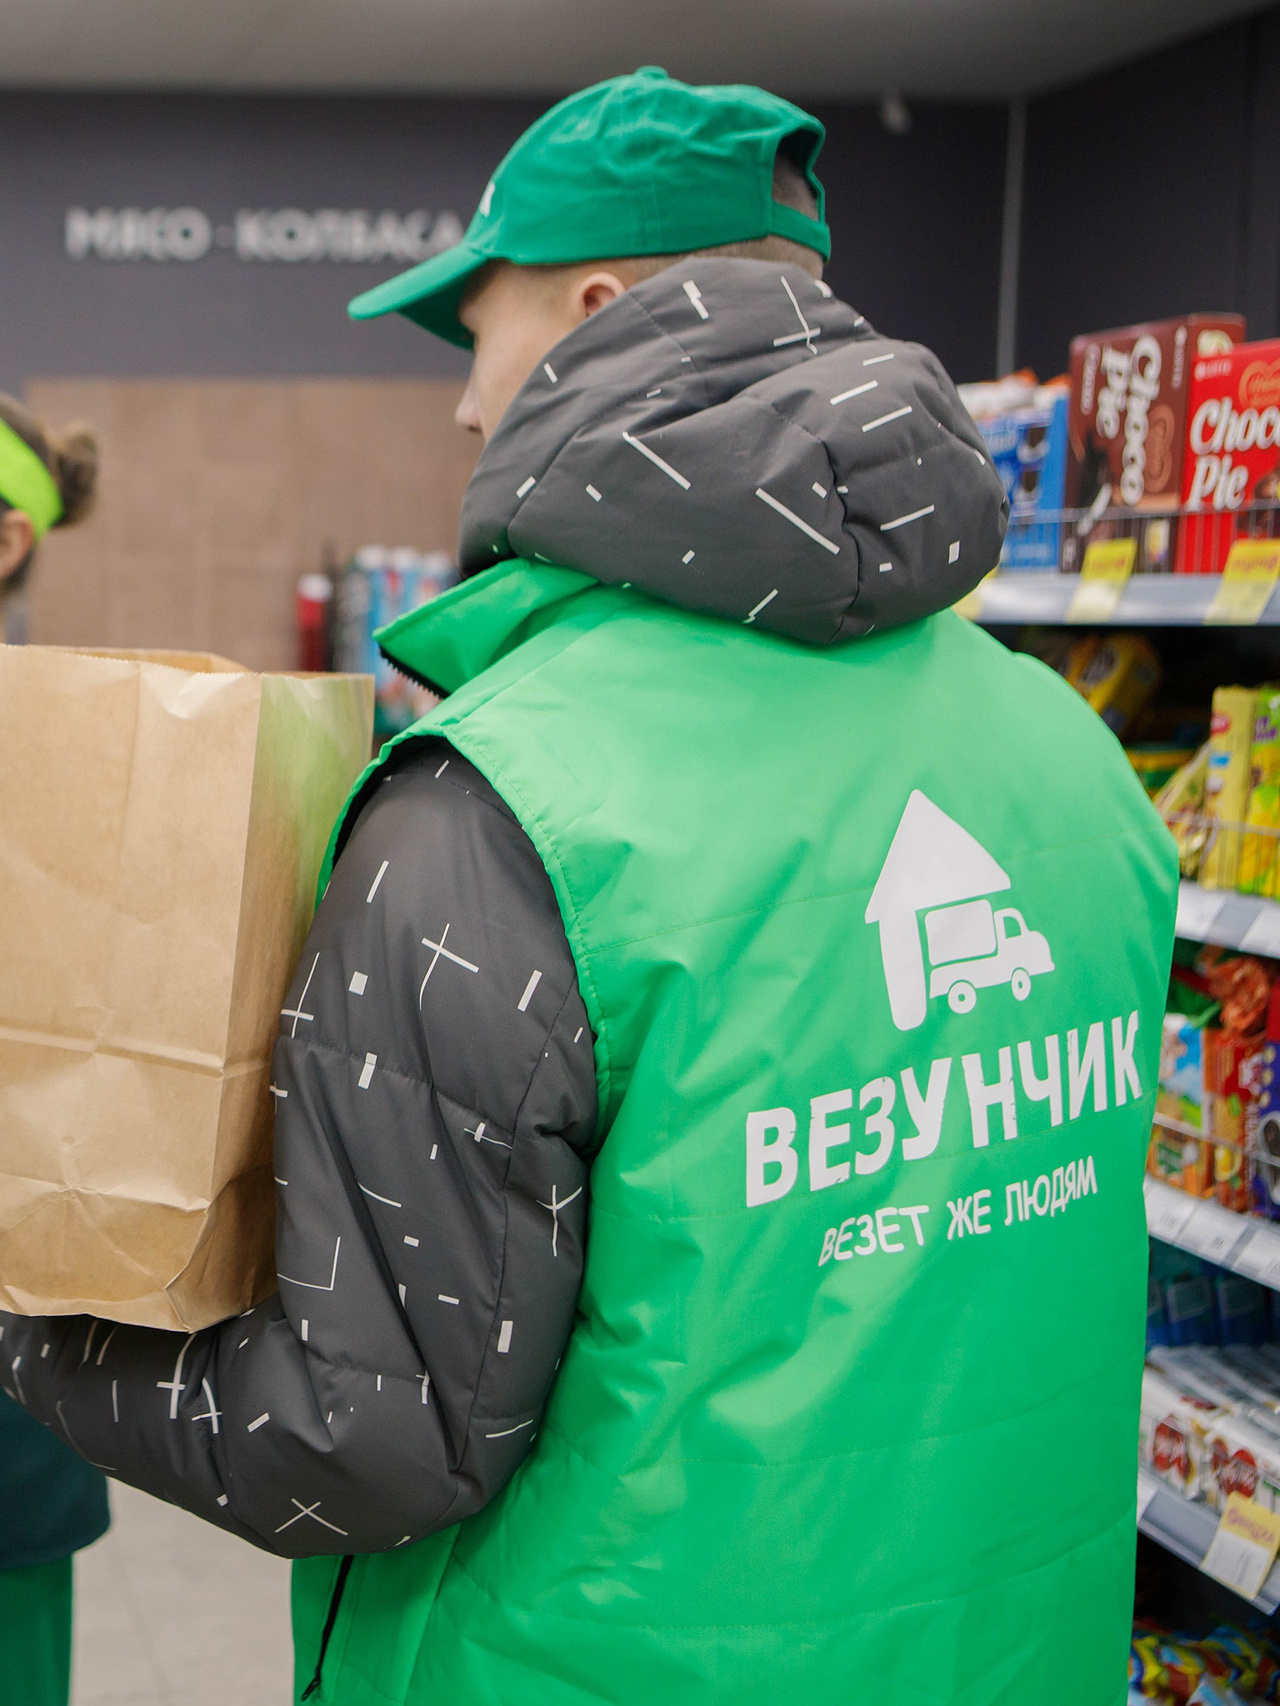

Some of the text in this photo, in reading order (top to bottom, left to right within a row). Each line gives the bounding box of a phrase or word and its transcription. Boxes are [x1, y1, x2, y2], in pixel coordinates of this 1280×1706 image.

[66, 207, 211, 260] МЯСО
[1190, 396, 1280, 456] Choc
[1186, 453, 1249, 512] Pie
[746, 1010, 1143, 1208] ВЕЗУНЧИК
[818, 1155, 1098, 1267] ВЕЗЕТ ЖЕ ЛЮДЯМ
